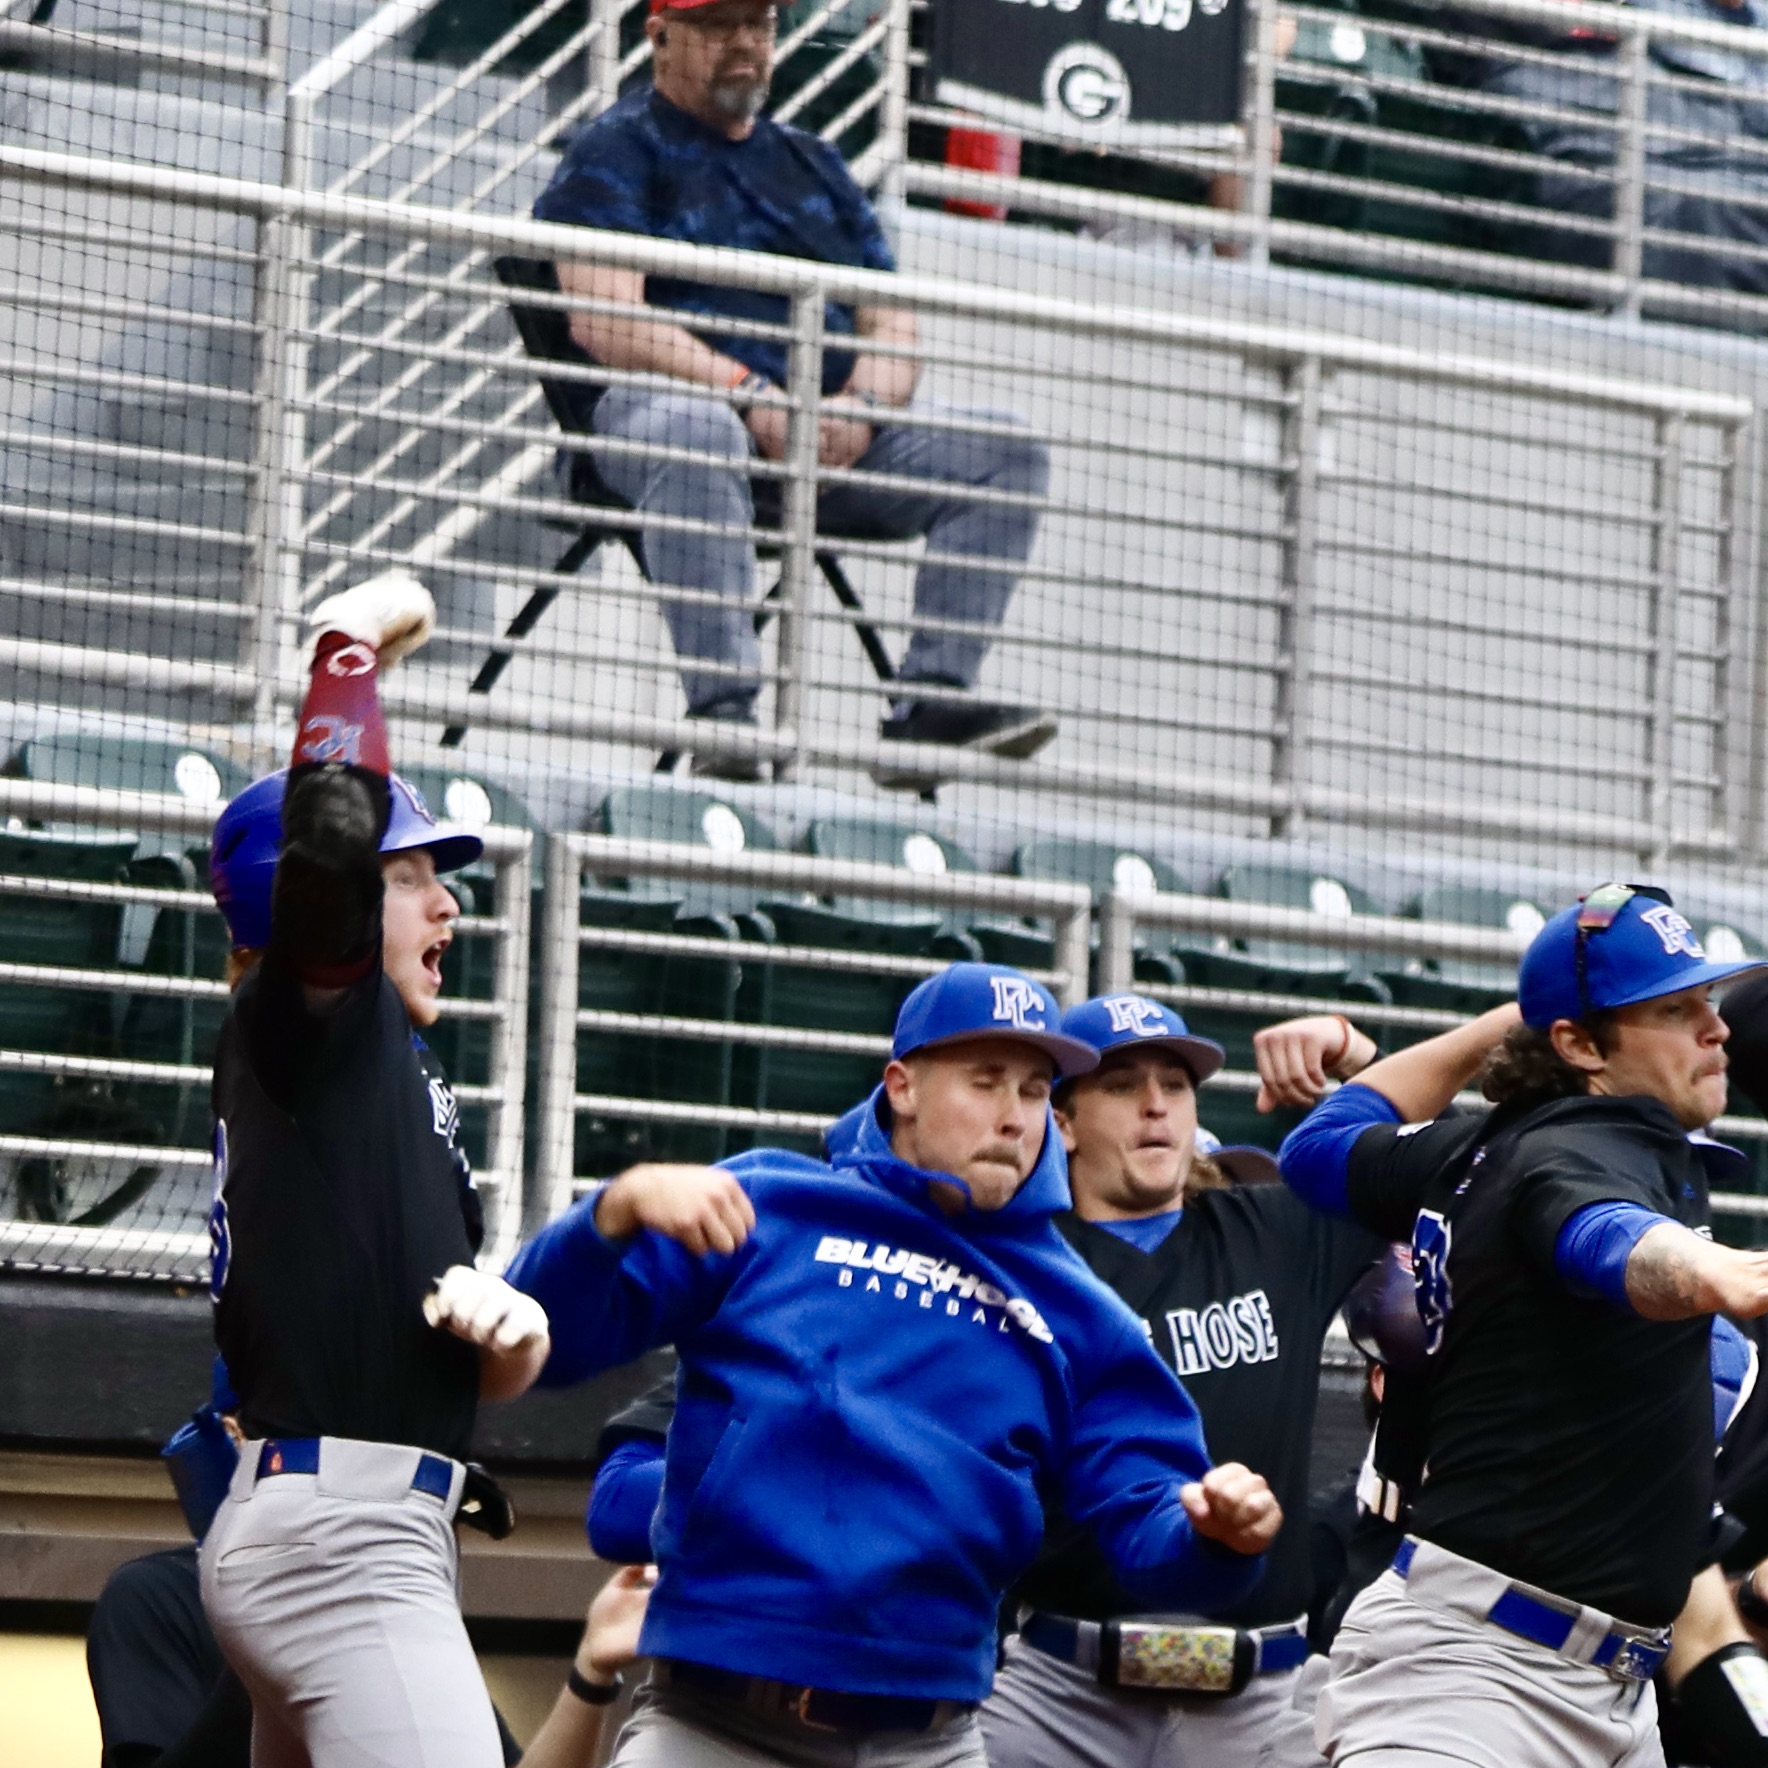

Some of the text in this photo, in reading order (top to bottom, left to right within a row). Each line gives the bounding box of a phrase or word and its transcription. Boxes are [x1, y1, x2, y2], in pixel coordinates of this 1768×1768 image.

[989, 976, 1046, 1032] PC
[1103, 998, 1169, 1037] PC
[814, 1236, 937, 1286] BLUE
[1165, 1288, 1280, 1376] HOSE
